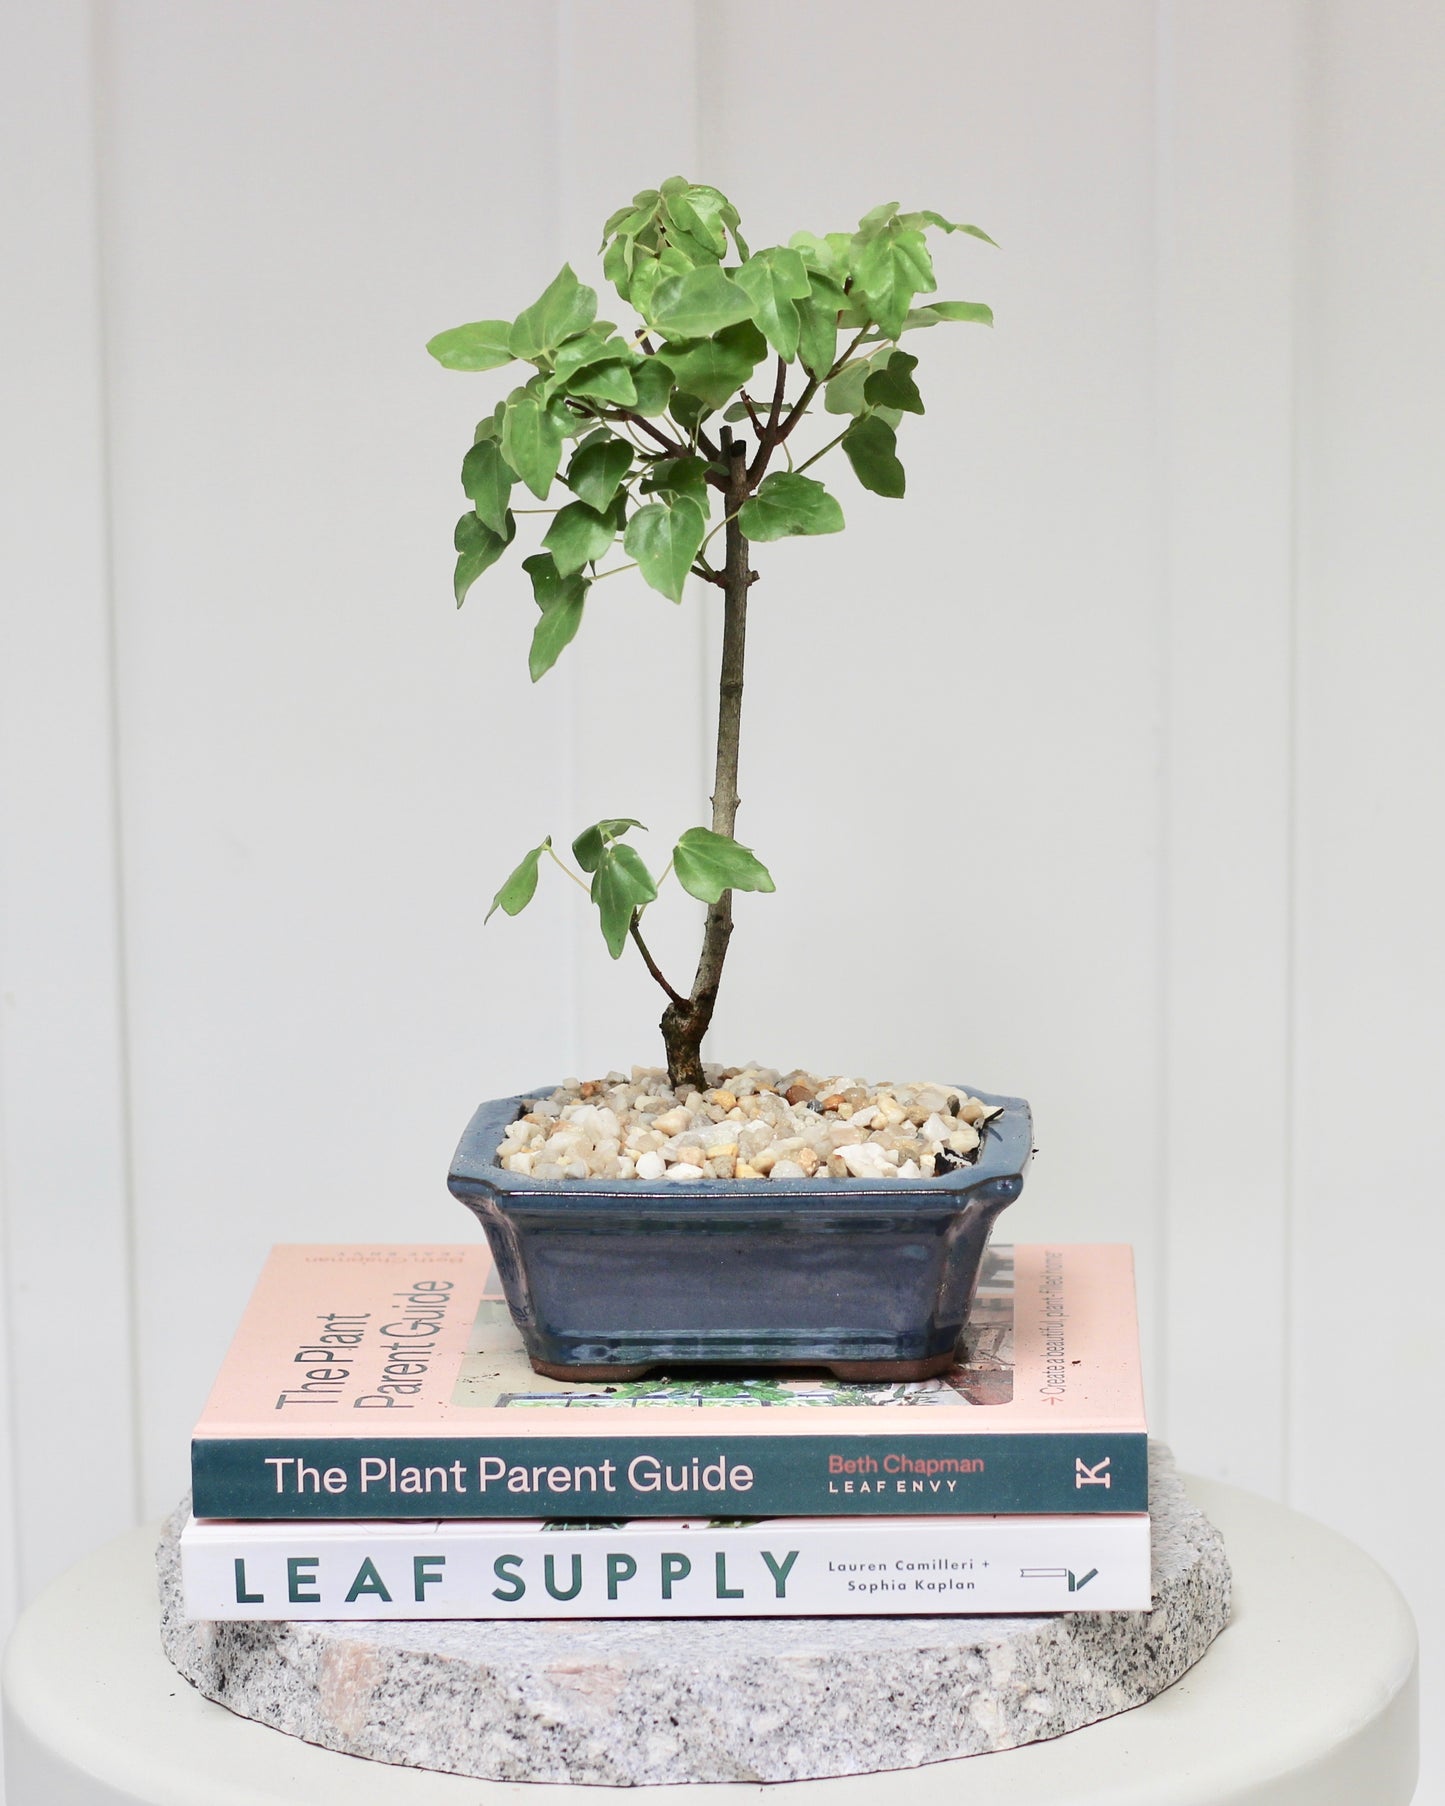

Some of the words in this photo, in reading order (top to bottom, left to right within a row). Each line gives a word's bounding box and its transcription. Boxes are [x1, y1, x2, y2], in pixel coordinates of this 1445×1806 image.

[379, 1280, 454, 1337] Guide
[294, 1313, 371, 1362] Plant
[275, 1368, 350, 1409] The
[353, 1342, 436, 1408] Parent
[1040, 1365, 1066, 1395] Create
[264, 1457, 347, 1493] The
[360, 1456, 467, 1493] Plant
[479, 1456, 616, 1492] Parent
[628, 1454, 755, 1491] Guide
[828, 1455, 879, 1474] Beth
[883, 1454, 985, 1476] Chapman
[1075, 1456, 1111, 1489] K
[829, 1480, 887, 1493] LEAF
[897, 1480, 958, 1493] ENVY
[234, 1555, 446, 1603] LEAF
[492, 1550, 800, 1602] SUPPLY
[828, 1561, 887, 1572] Lauren
[895, 1559, 974, 1572] Camilleri
[848, 1579, 907, 1594] Sophia
[915, 1579, 976, 1594] Kaplan
